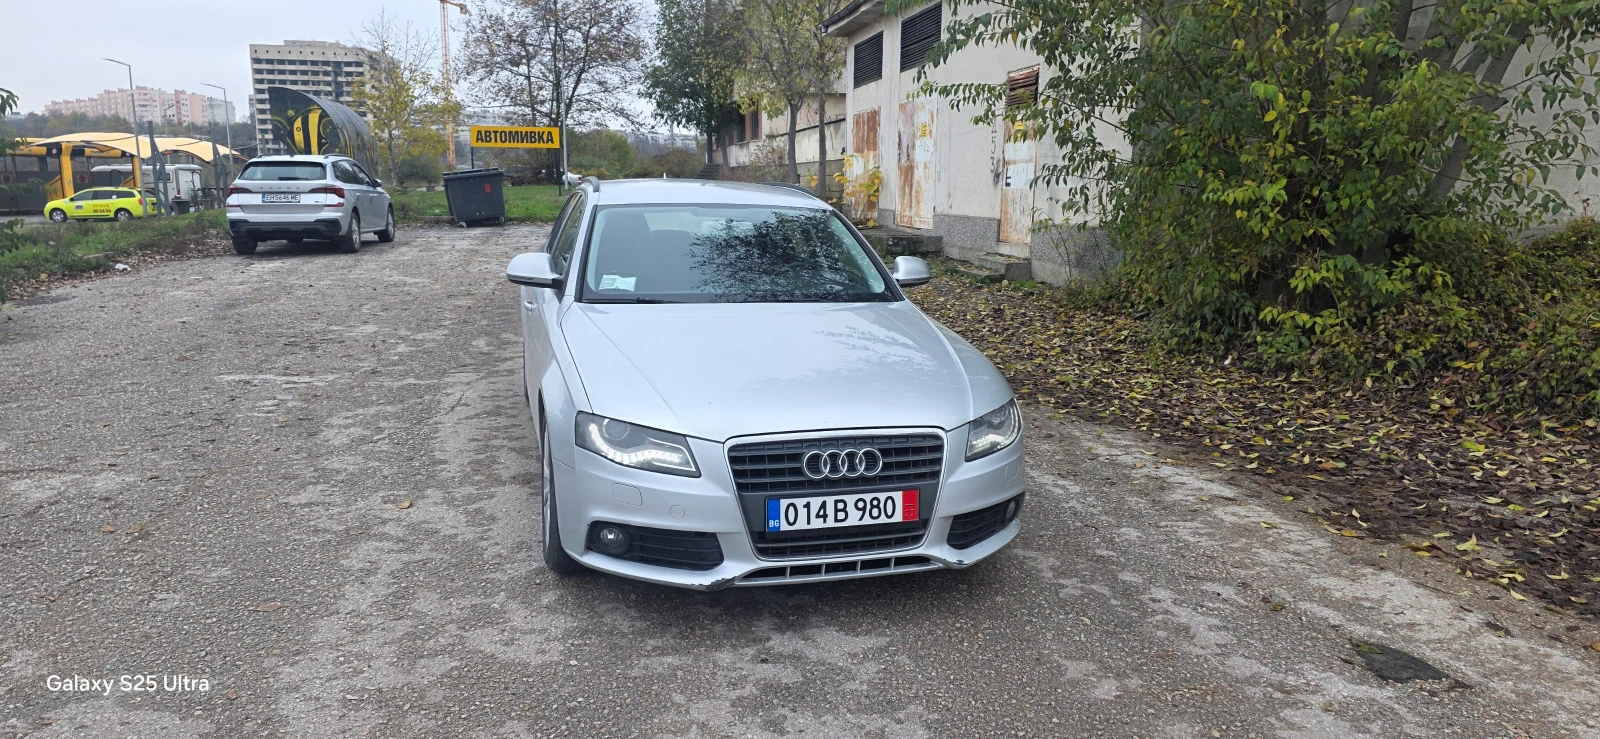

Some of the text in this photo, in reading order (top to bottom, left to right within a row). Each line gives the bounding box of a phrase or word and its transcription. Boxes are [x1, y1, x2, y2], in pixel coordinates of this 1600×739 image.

[476, 130, 554, 144] АВТОМИВКА
[784, 496, 896, 526] 014 B 980
